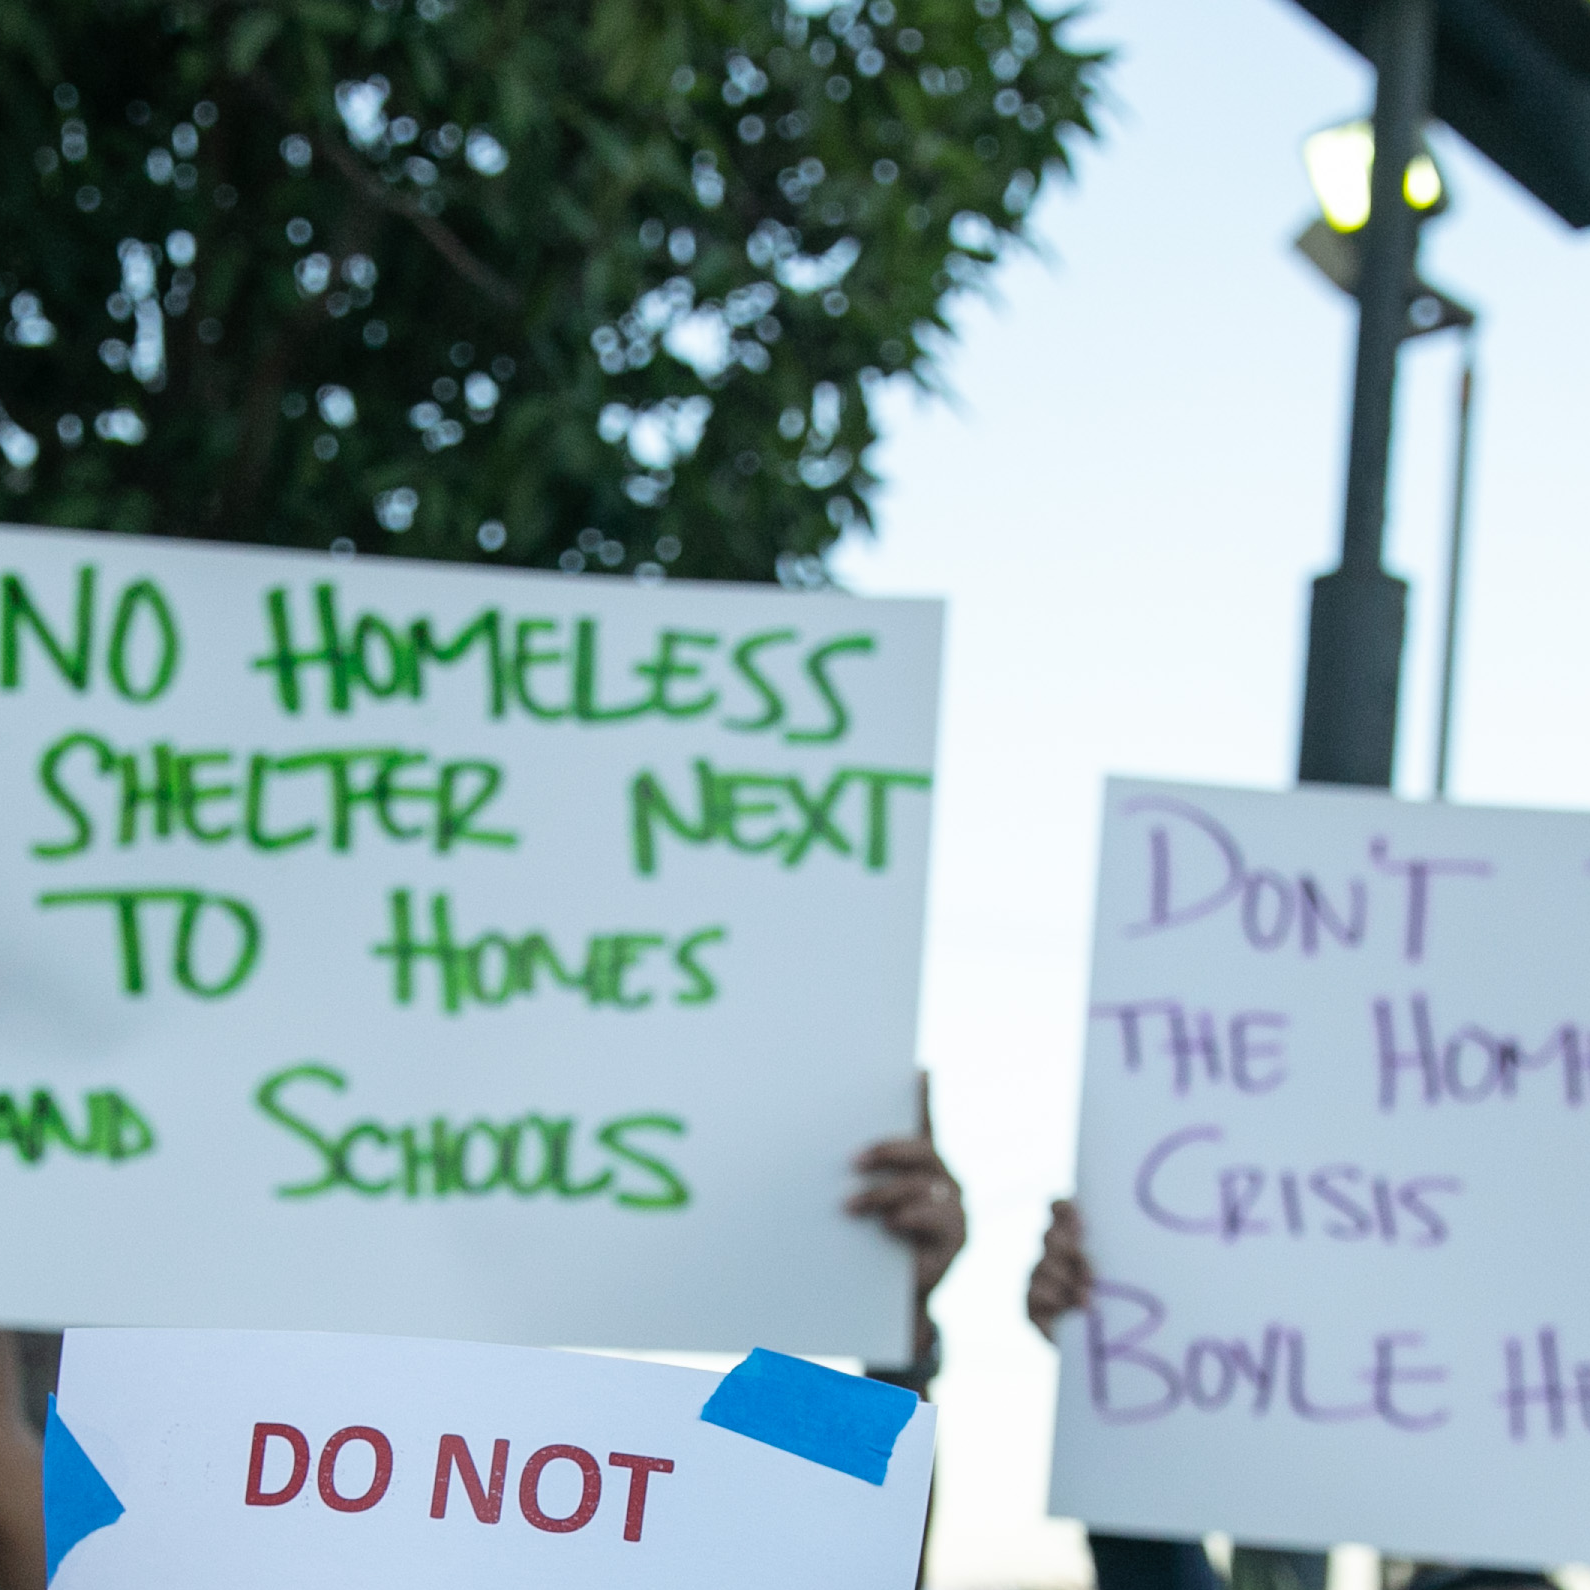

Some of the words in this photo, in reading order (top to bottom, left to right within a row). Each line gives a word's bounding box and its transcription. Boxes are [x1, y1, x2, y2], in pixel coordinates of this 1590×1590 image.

[251, 579, 878, 747] HOMELESS
[30, 728, 520, 863] SHELTER
[628, 757, 933, 877] NEXT
[36, 885, 263, 1000] TO
[371, 886, 728, 1016] HOMES
[1124, 794, 1496, 964] DON'T
[1093, 1000, 1289, 1096] THE
[253, 1062, 693, 1213] SCHOOLS
[1135, 1124, 1464, 1246] CRISIS
[1085, 1279, 1452, 1430] BOYLE
[243, 1421, 394, 1515] DO
[429, 1433, 676, 1543] NOT
